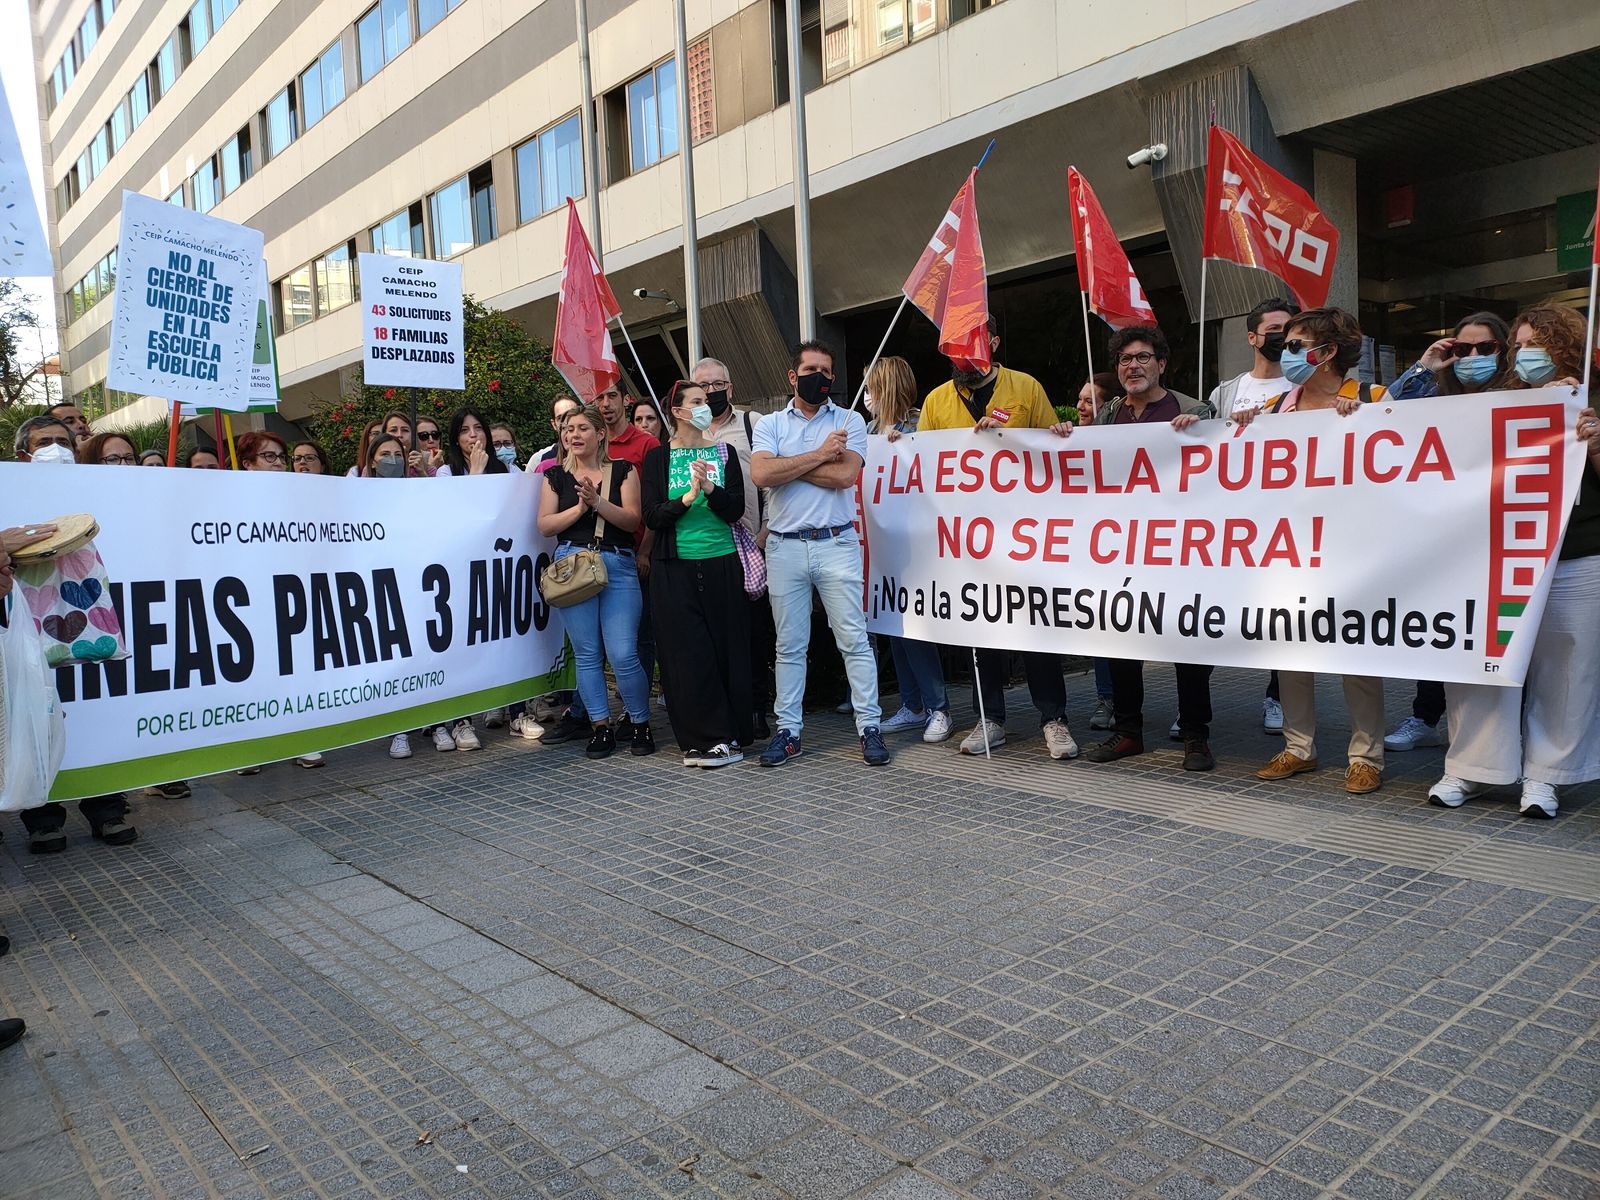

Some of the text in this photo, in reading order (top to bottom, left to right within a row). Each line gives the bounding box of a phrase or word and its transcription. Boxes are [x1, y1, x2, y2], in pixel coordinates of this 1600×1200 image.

[145, 231, 239, 262] CEIP CAMACHO MELENDO
[168, 250, 217, 281] NO AL
[398, 267, 423, 275] CEIP
[147, 266, 234, 305] CIERRE DE
[382, 276, 437, 288] CAMACHO
[385, 288, 438, 299] MELENDO
[146, 287, 231, 324] UNIDADES
[371, 304, 452, 322] 43 SOLICITUDES
[163, 312, 210, 340] EN LA
[373, 327, 448, 345] 18 FAMILIAS
[147, 329, 221, 362] ESCUELA
[371, 346, 455, 364] DESPLAZADAS
[872, 424, 1456, 505] ¡LA ESCUELA PÚBLICA
[669, 477, 692, 490] ARA
[191, 521, 385, 544] CEIP CAMACHO MELENDO
[937, 516, 1324, 568] NO SE CIERRA!
[272, 567, 413, 676] PARA
[422, 563, 453, 653] 3
[467, 537, 551, 647] AÑOS
[872, 575, 1476, 651] ¡No a la SUPRESIÓN de unidades!
[137, 670, 445, 737] POR EL DERECHO A LA ELECCIÓN DE CENTRO
